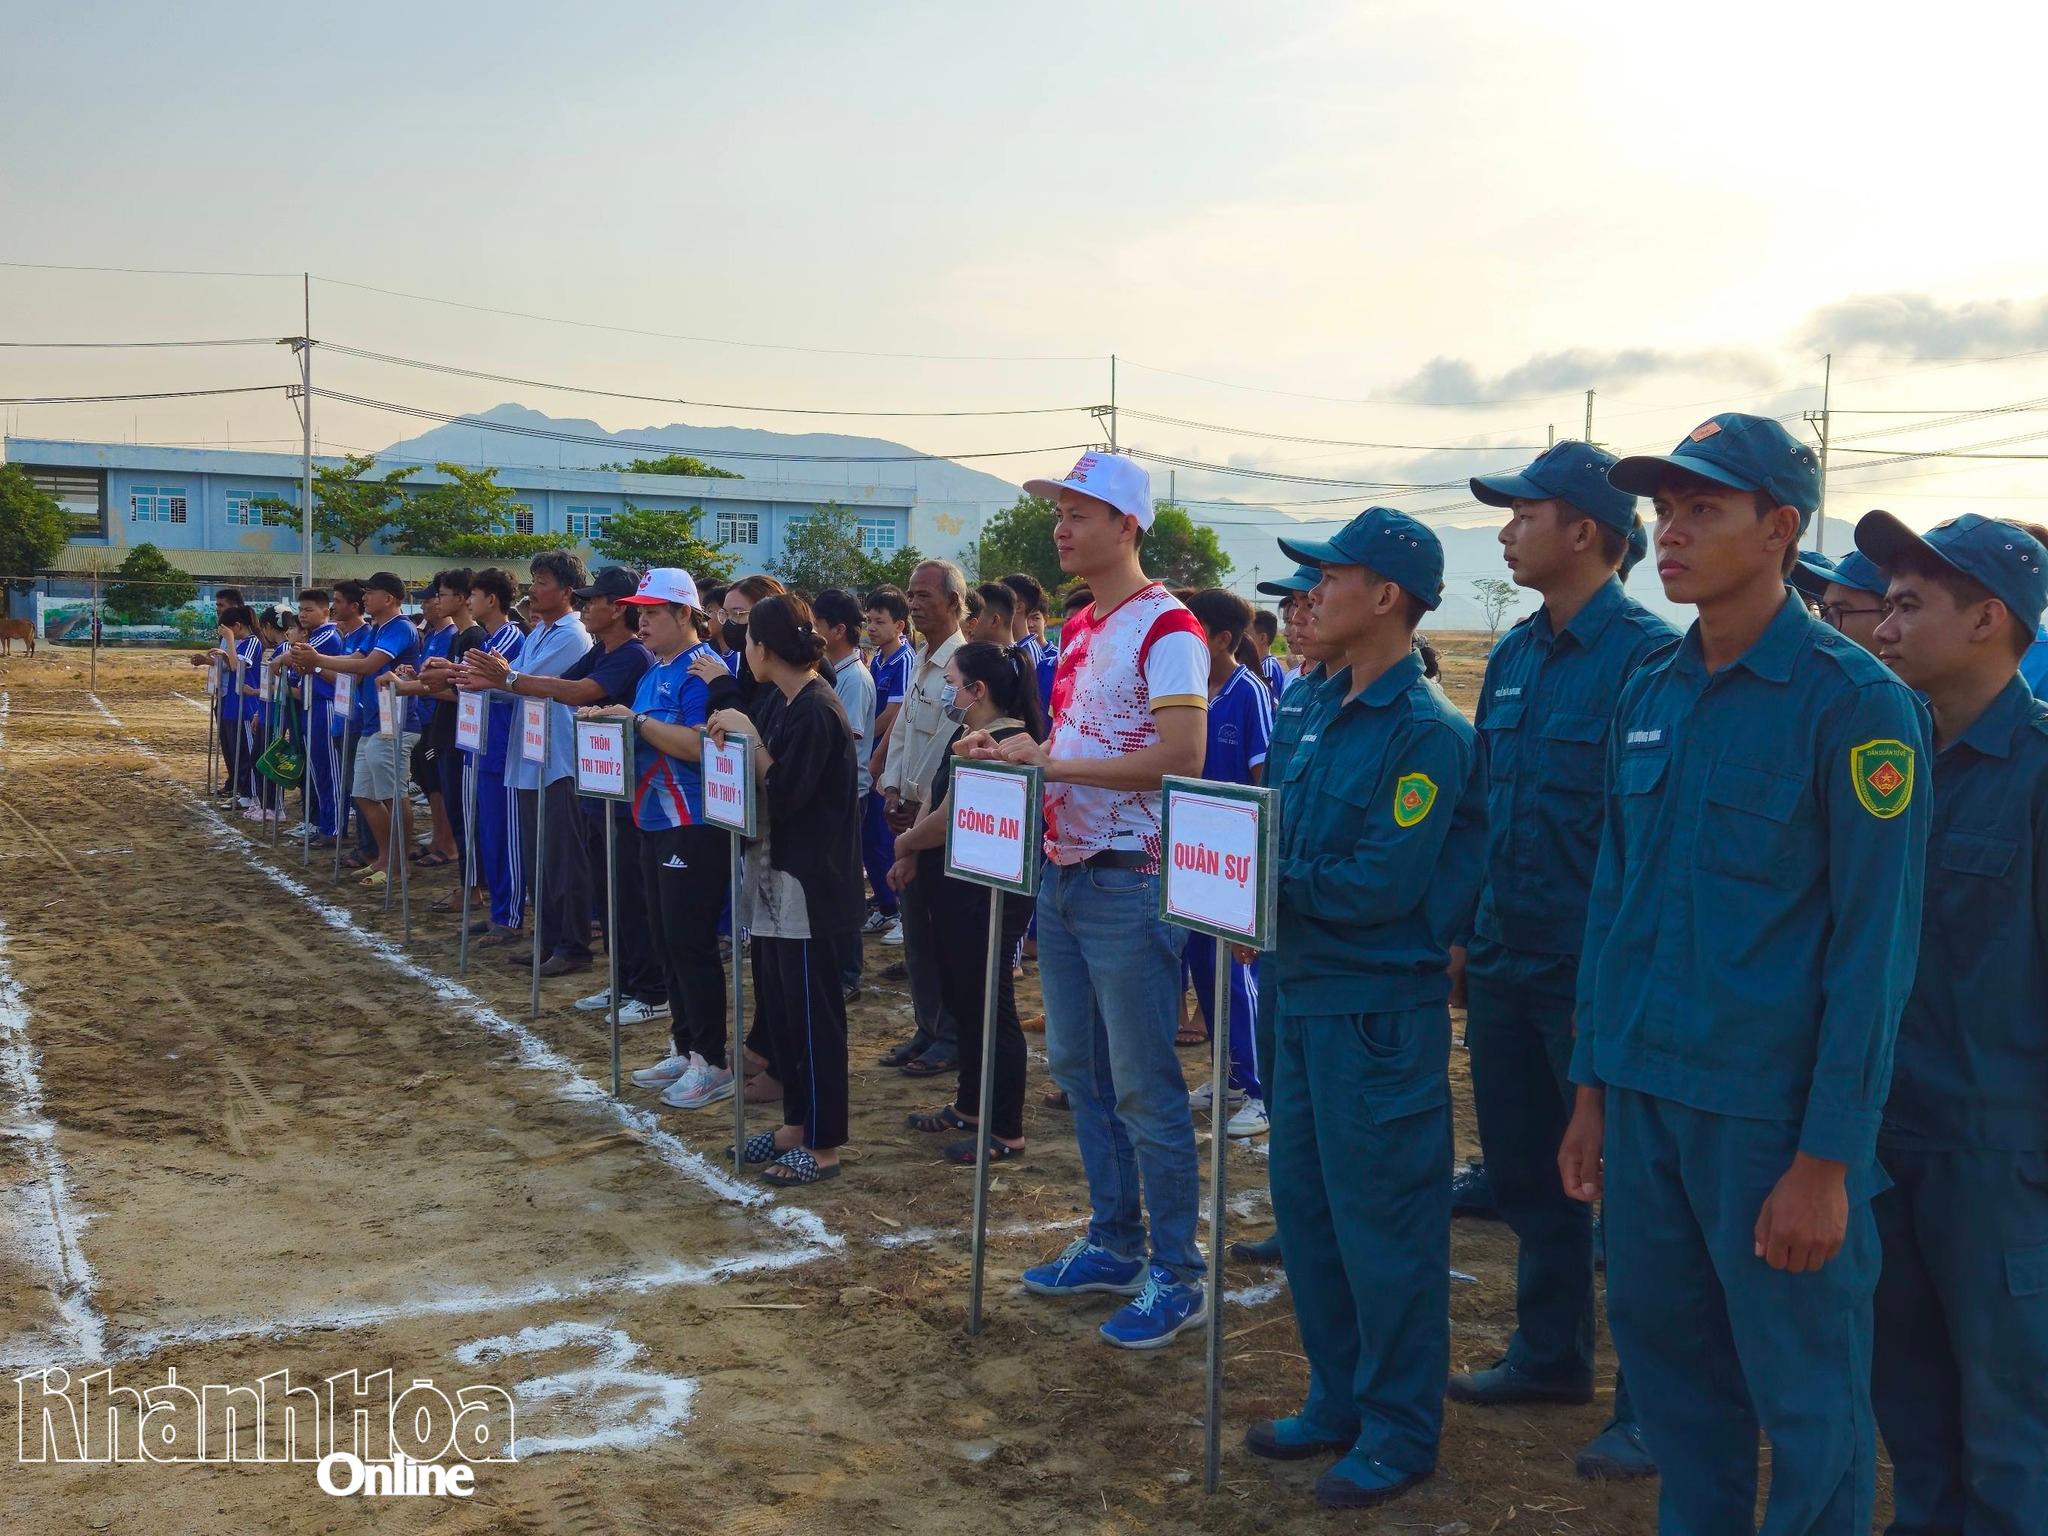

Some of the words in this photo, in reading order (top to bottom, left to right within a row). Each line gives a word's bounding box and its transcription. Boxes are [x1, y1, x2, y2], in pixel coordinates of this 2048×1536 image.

[589, 733, 611, 751] THÔN
[581, 758, 593, 772] TRI
[594, 756, 614, 775] THUỶ
[615, 764, 621, 776] 2
[715, 754, 733, 775] THÔN
[707, 781, 718, 798] TRI
[719, 782, 736, 804] THUỶ
[738, 790, 742, 806] 1
[957, 806, 995, 835] CÔNG
[998, 817, 1020, 840] AN
[1174, 842, 1219, 876] QUÂN
[1224, 854, 1251, 888] SỰ
